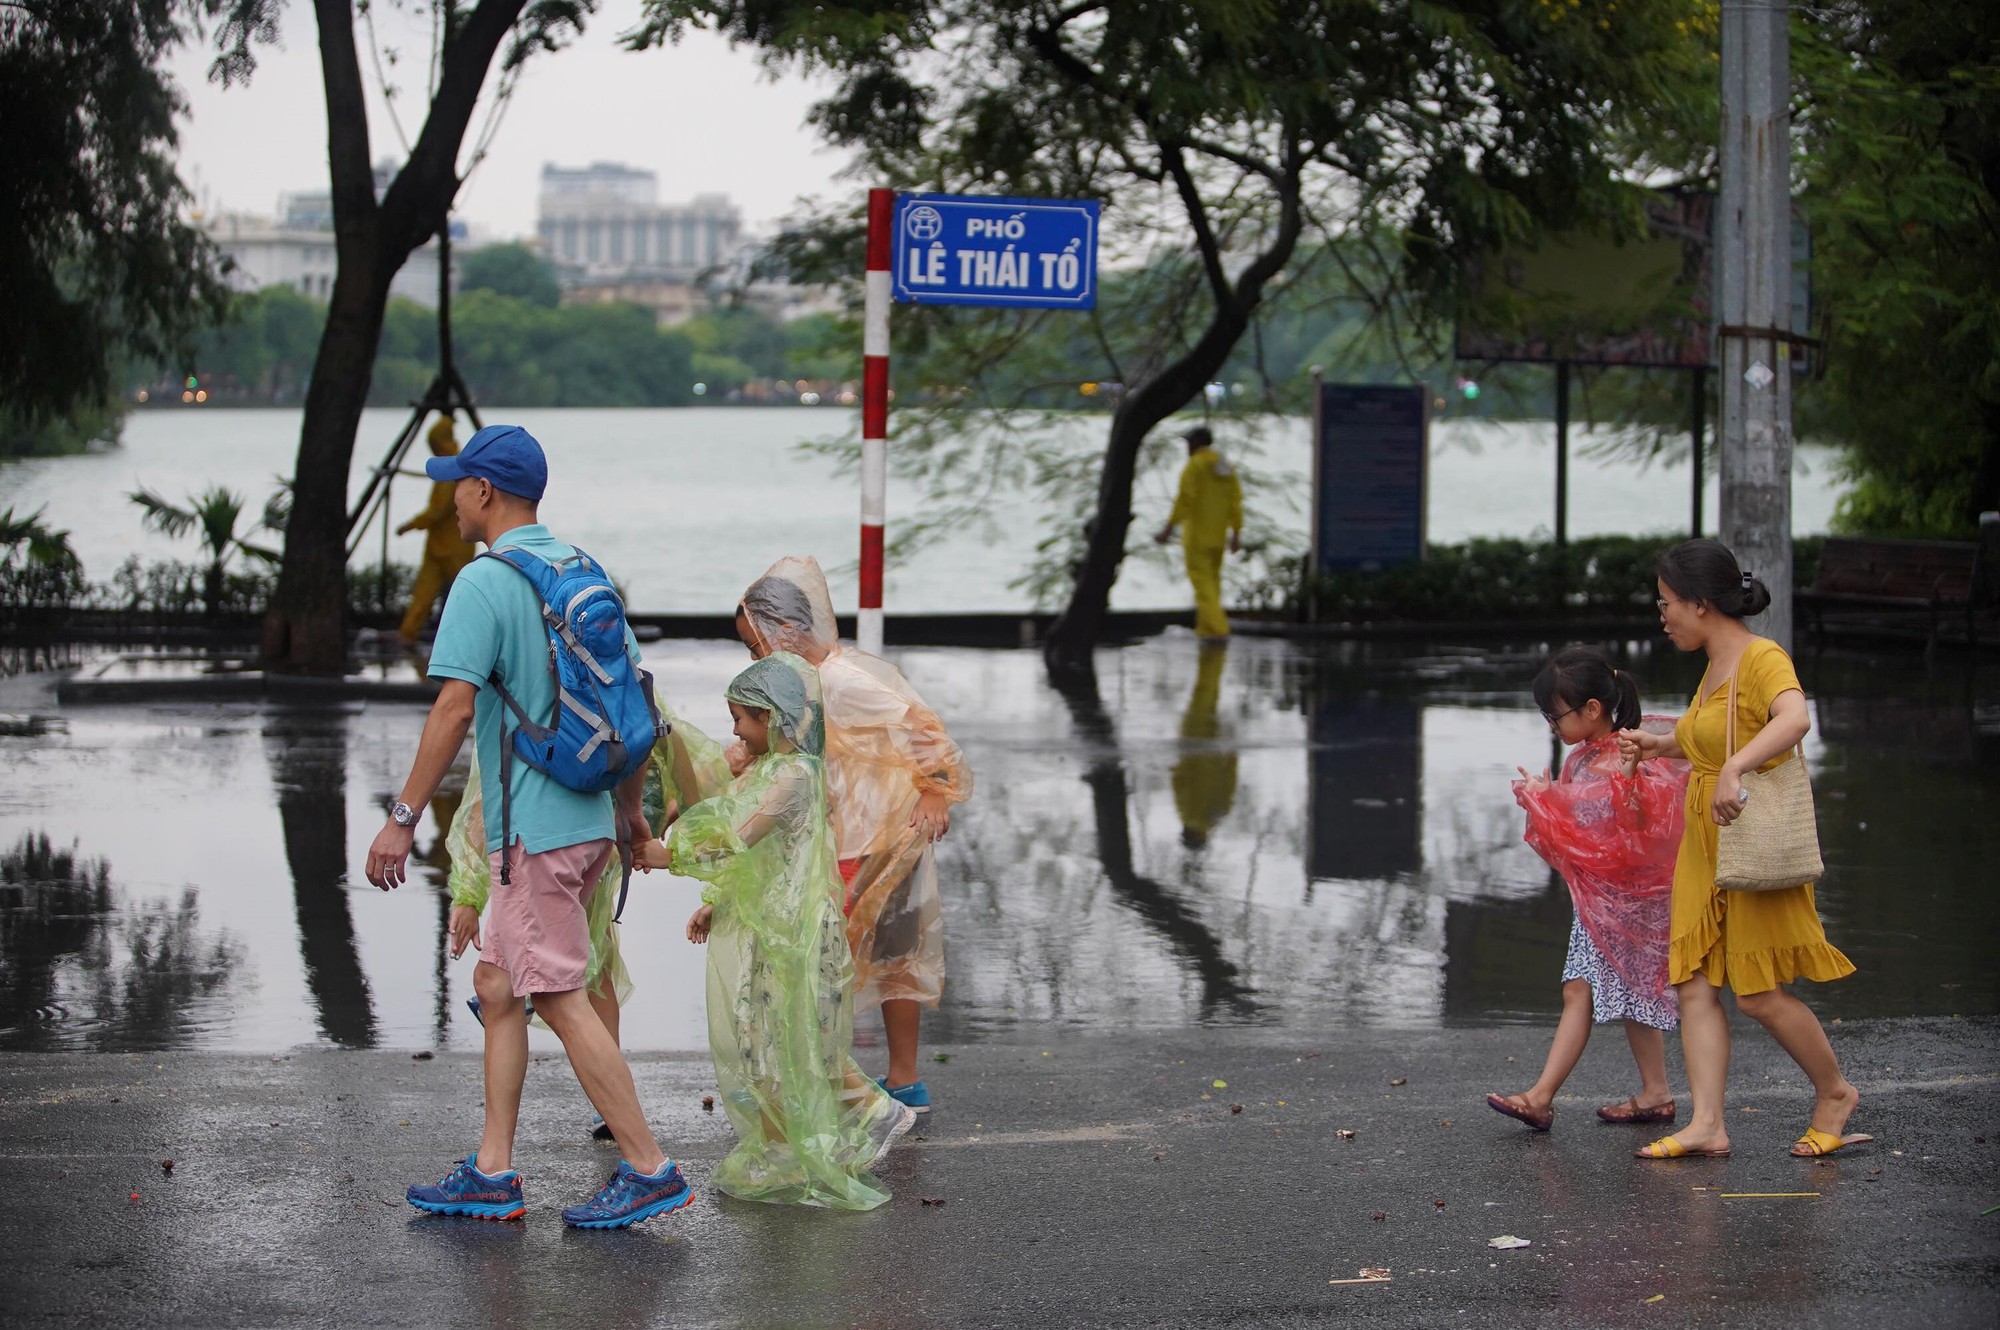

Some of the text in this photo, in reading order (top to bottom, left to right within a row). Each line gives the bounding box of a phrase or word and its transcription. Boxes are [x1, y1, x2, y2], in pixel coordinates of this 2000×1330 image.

[966, 211, 1027, 239] PHỐ
[909, 237, 1082, 290] LÊ THÁI TỔ
